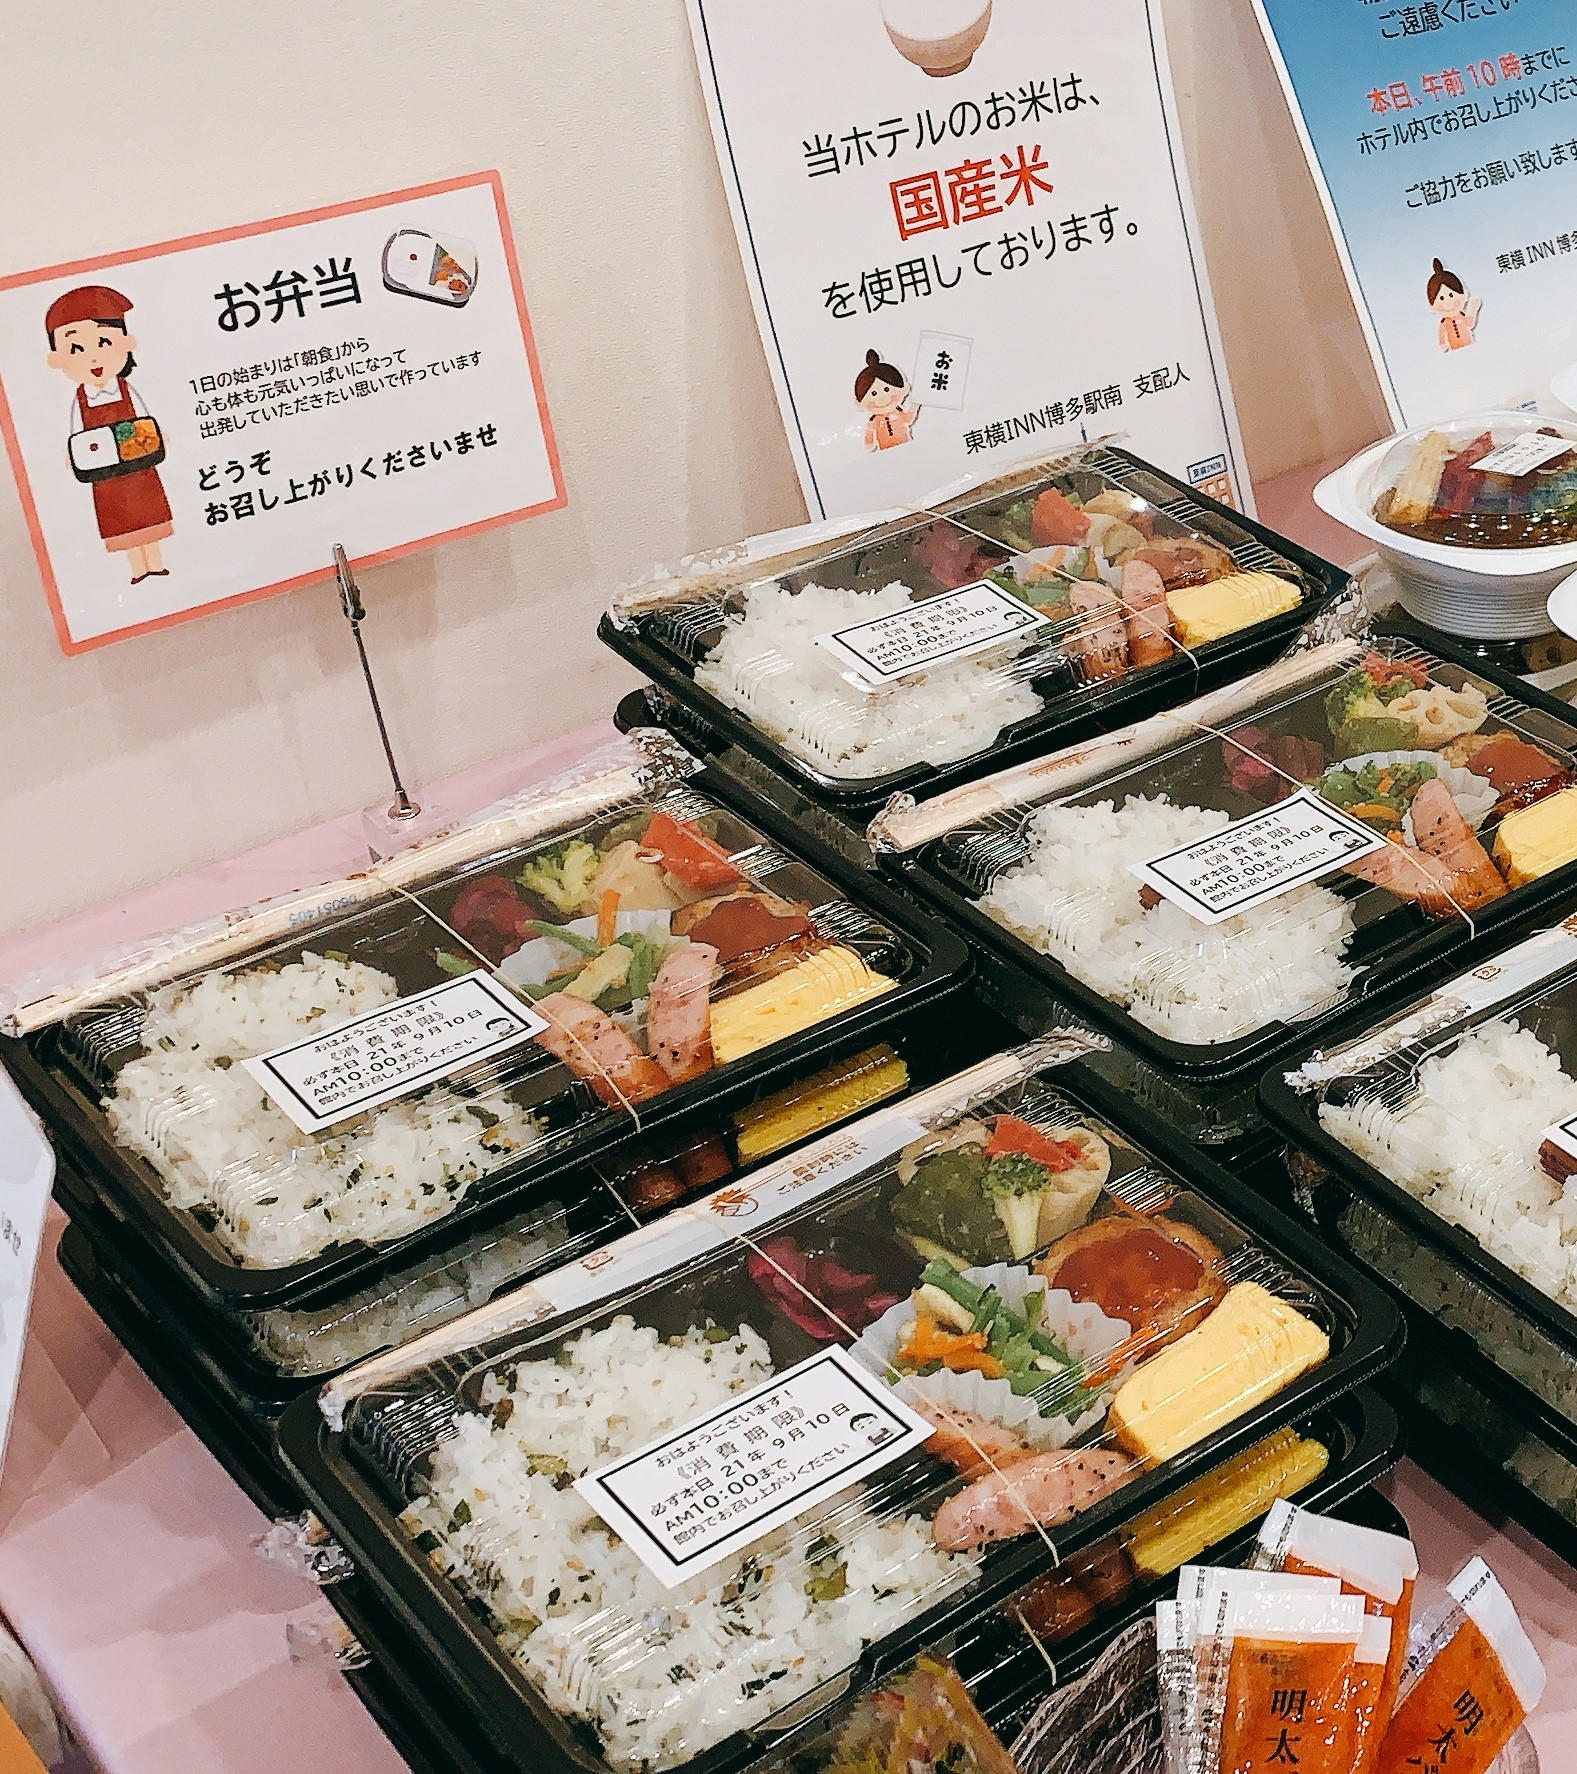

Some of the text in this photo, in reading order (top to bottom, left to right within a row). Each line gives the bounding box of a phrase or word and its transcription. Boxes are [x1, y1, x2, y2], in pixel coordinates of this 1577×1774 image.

[802, 73, 1100, 178] 当ホテルのお米は、
[889, 144, 1053, 241] 国産米
[213, 256, 362, 332] お弁当
[821, 204, 1138, 319] を使用しております。
[189, 337, 371, 395] 1日の始まりは「朝食」から
[195, 348, 407, 416] 心も体も元気いっぱいになって
[200, 351, 482, 439] 出発していただきたい思いで作っています
[930, 350, 953, 392] お米
[1133, 362, 1191, 399] 支配人
[198, 451, 272, 491] どうぞ
[205, 424, 499, 526] お召し上がりくださいませ
[665, 1457, 789, 1532] AM10:00まで
[672, 1443, 851, 1546] 館内でお召し上がりください
[1264, 1689, 1308, 1774] 明太
